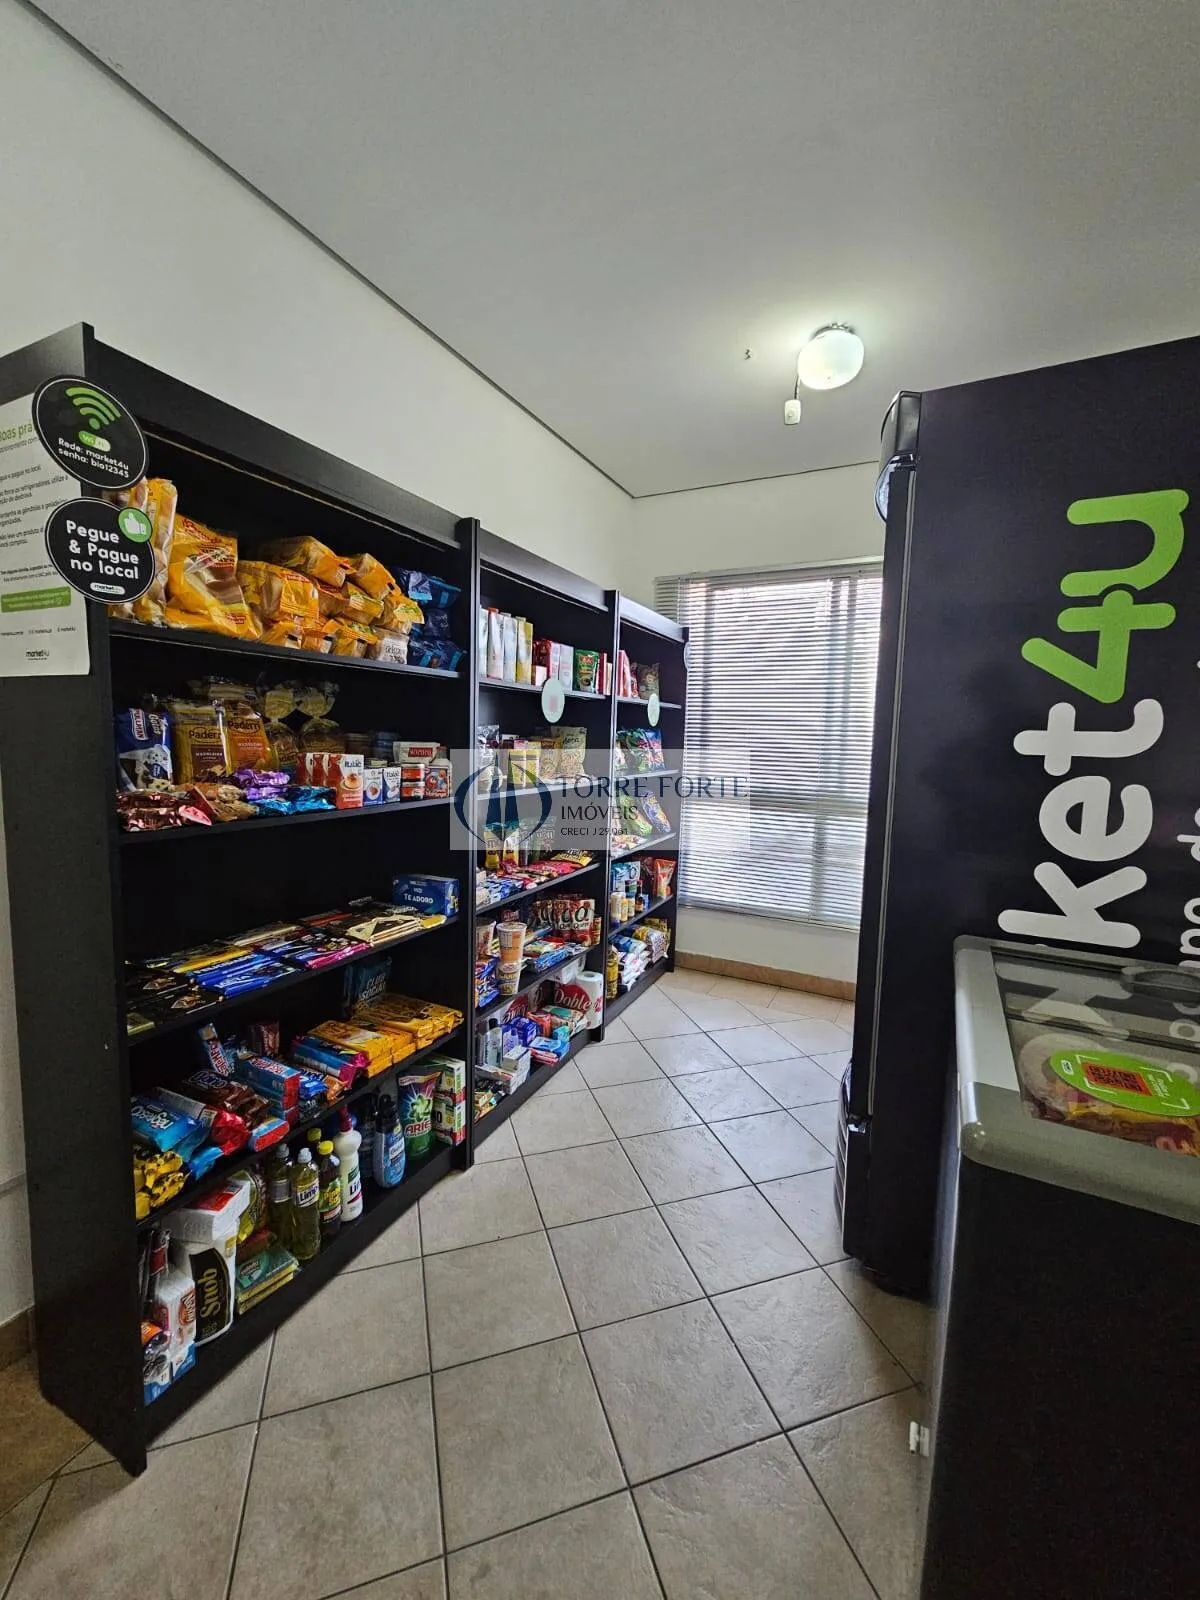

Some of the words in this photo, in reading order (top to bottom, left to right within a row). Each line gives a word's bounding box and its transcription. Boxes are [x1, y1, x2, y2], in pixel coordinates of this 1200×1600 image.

[58, 437, 84, 453] Rede:
[85, 449, 129, 470] market4u
[58, 448, 89, 464] senha:
[66, 519, 120, 544] Pegue
[69, 539, 81, 555] &
[87, 541, 139, 564] Pague
[70, 557, 93, 572] no
[99, 560, 139, 579] local
[404, 893, 412, 901] TE
[412, 895, 434, 904] ADORO
[405, 1121, 432, 1135] ARIE
[197, 1268, 220, 1318] Snob
